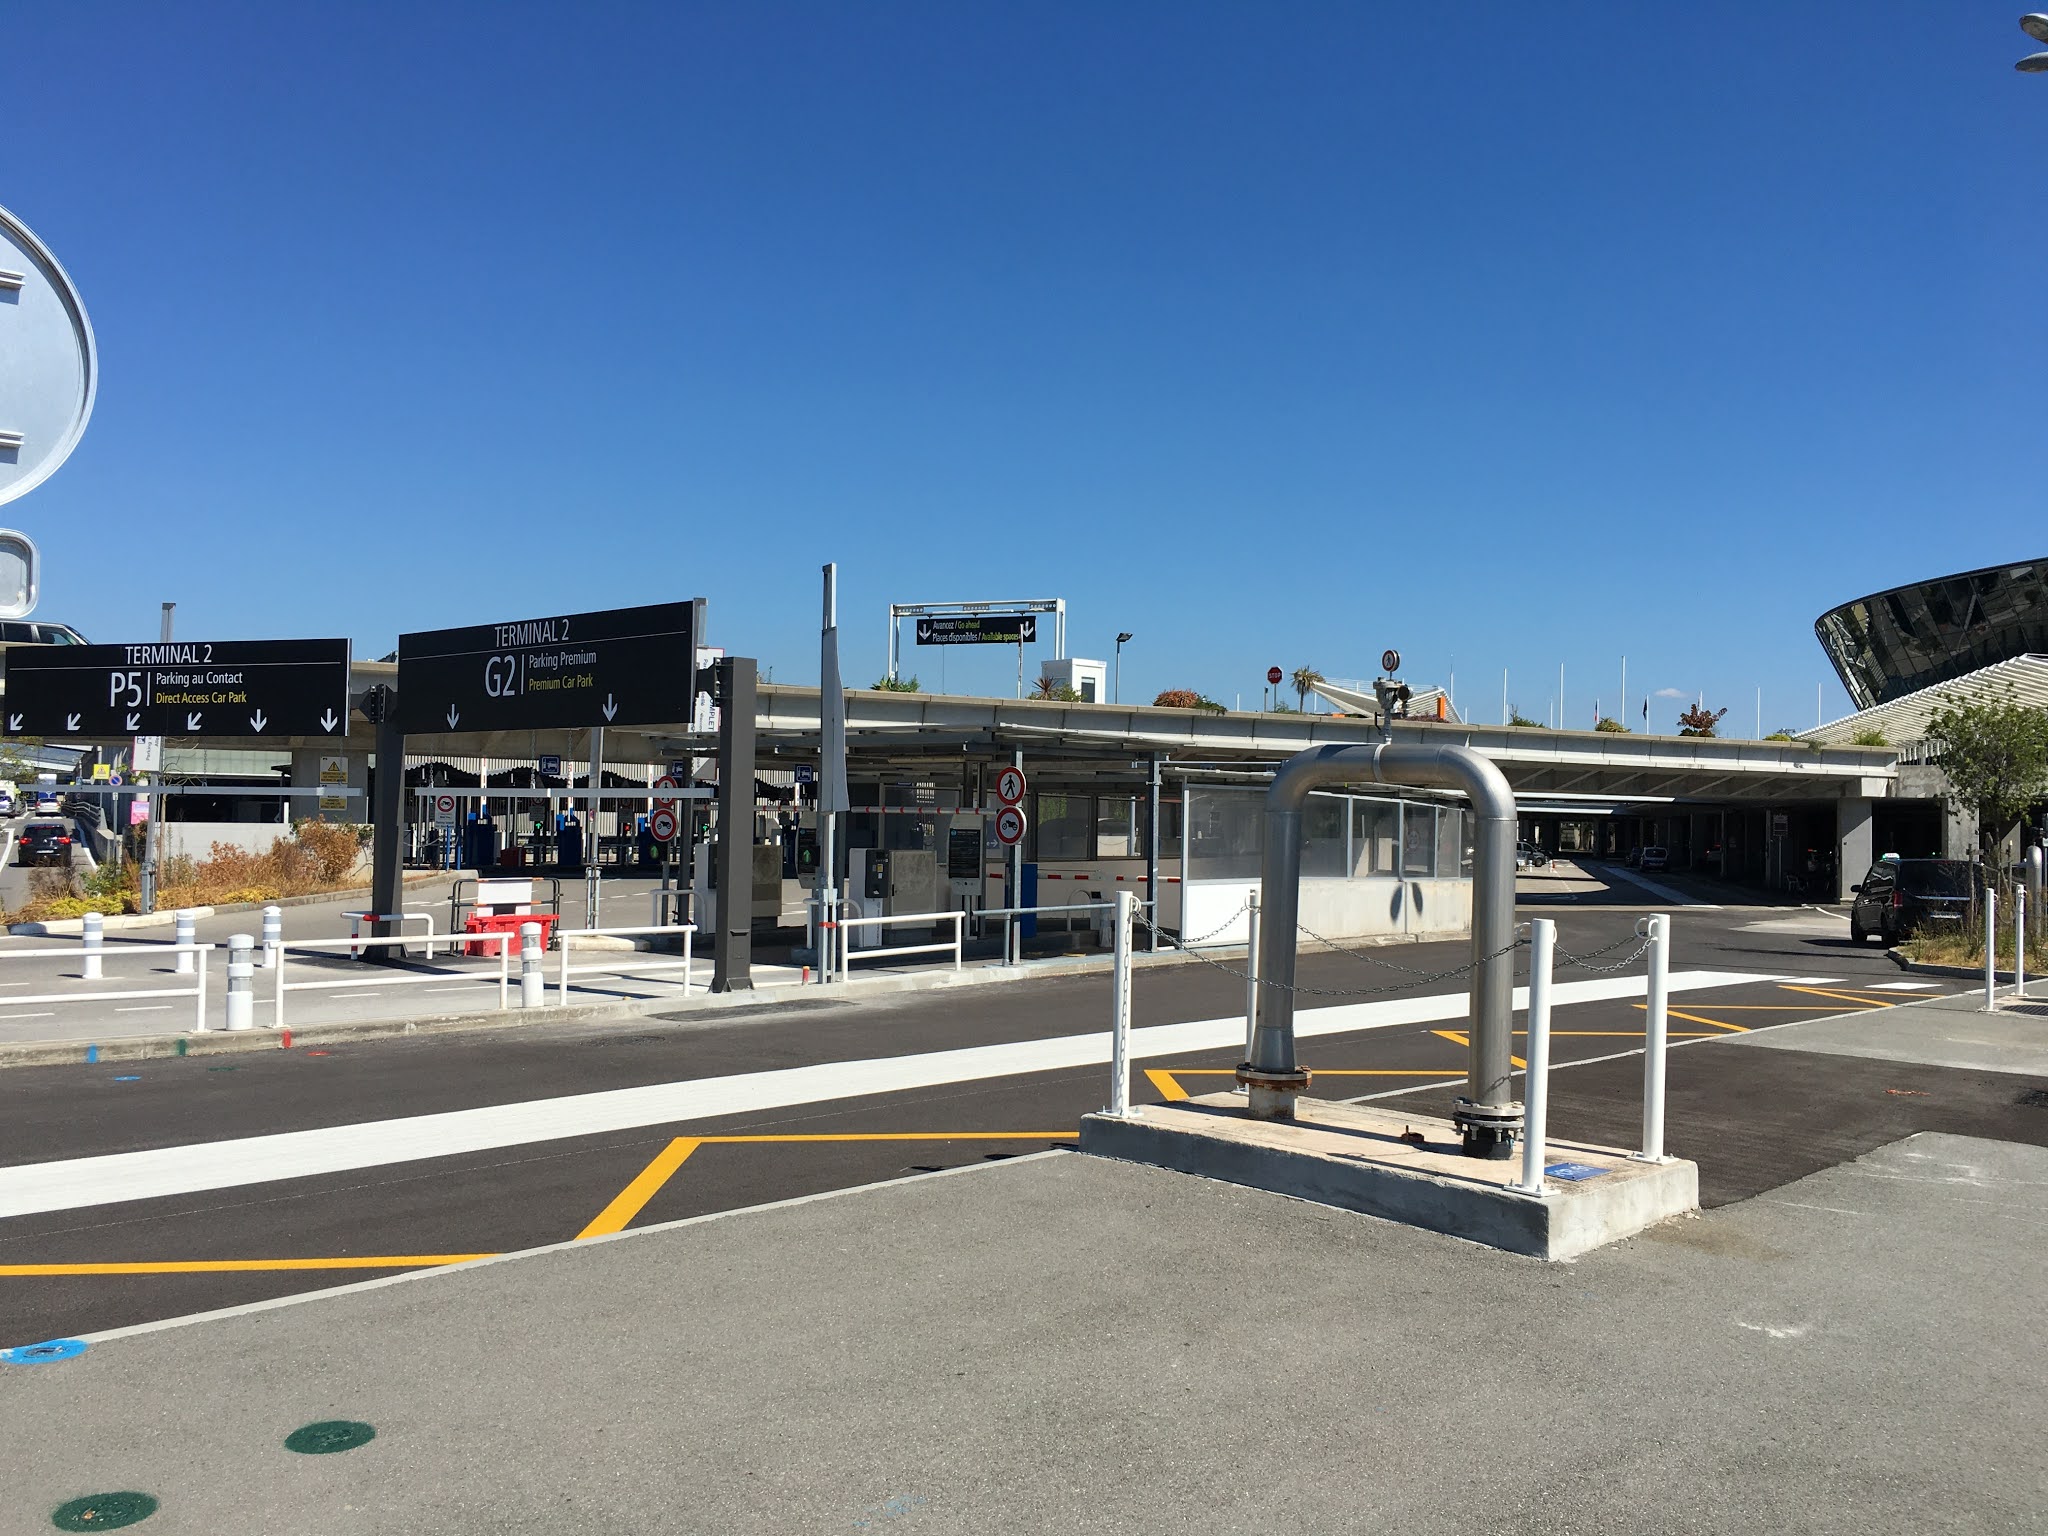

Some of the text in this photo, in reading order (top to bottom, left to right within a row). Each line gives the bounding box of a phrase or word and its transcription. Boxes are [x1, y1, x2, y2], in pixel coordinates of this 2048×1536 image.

[495, 619, 570, 647] TERMINAL 2
[932, 620, 954, 630] Avancez
[932, 632, 949, 642] Places
[949, 632, 978, 643] disponibles
[125, 644, 212, 665] TERMINAL 2
[529, 650, 597, 671] Parking Premium
[156, 671, 243, 688] Parking au Contact
[485, 655, 516, 697] G2
[529, 673, 593, 691] Premium Car Park
[110, 671, 142, 707] P5
[156, 691, 247, 704] Direct Access Car Park
[708, 699, 716, 731] OMPLET
